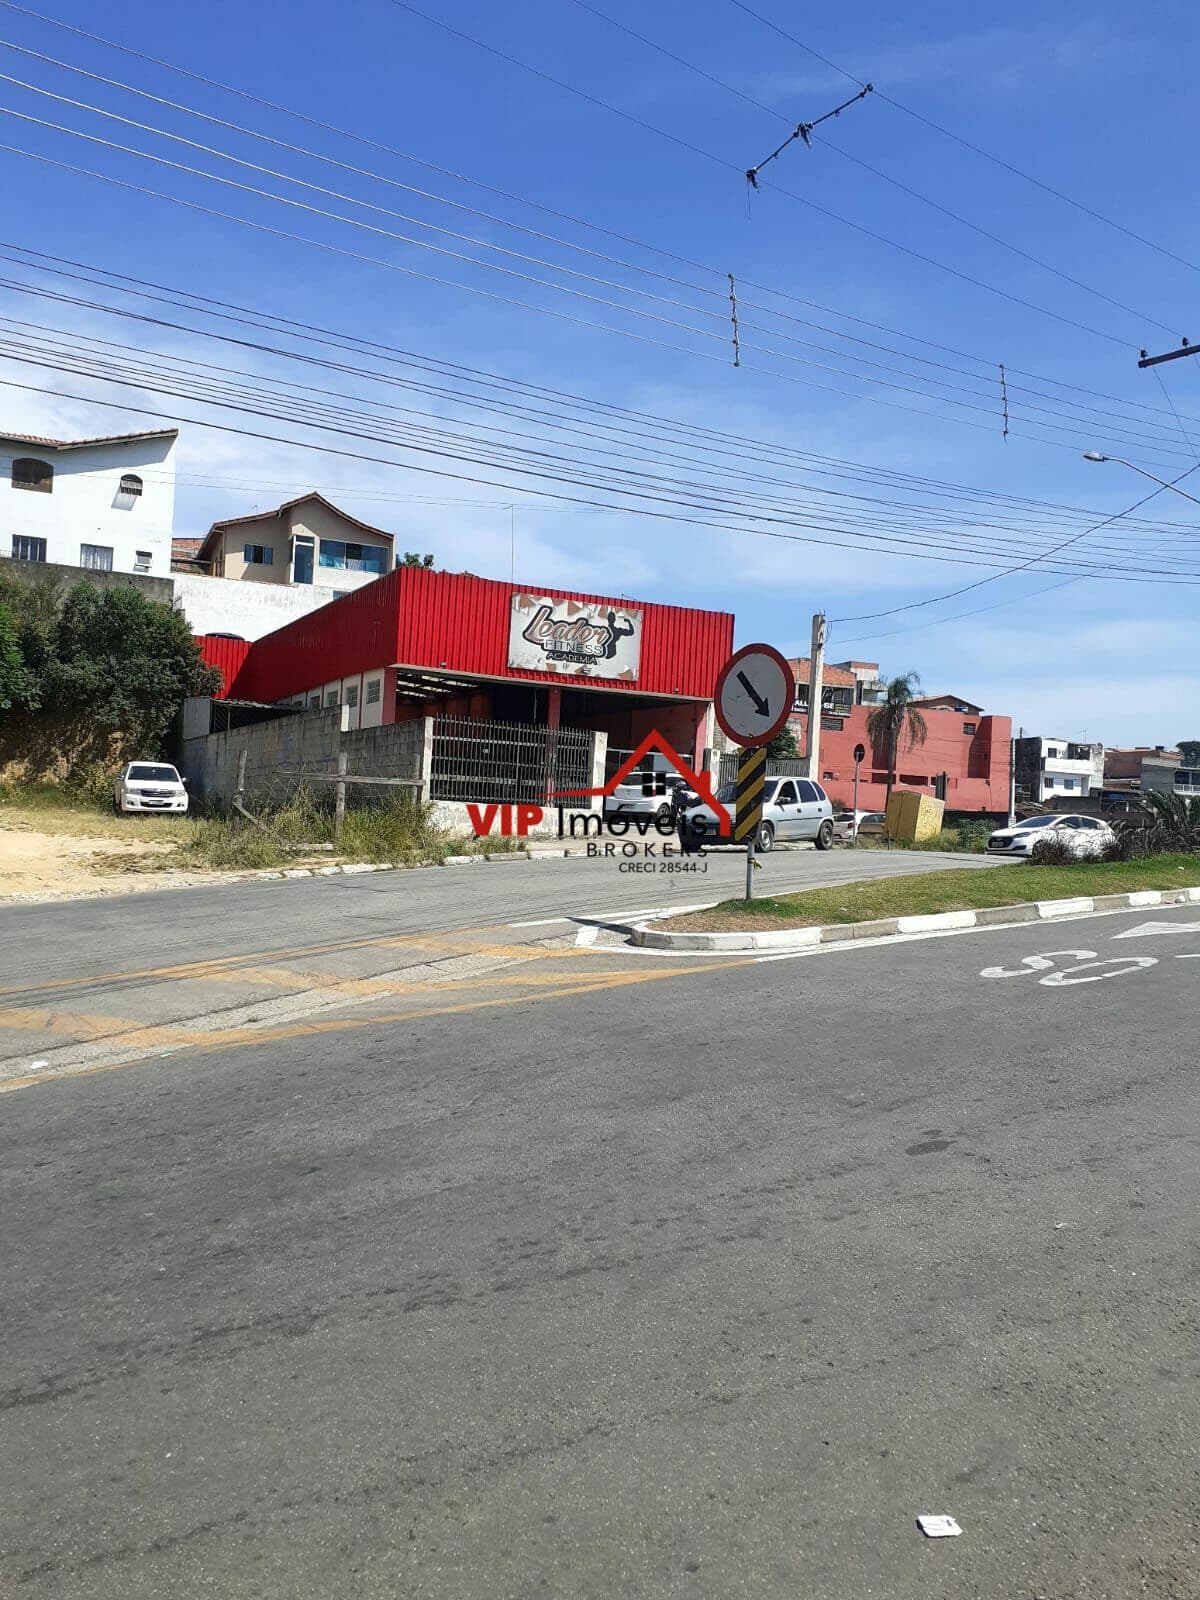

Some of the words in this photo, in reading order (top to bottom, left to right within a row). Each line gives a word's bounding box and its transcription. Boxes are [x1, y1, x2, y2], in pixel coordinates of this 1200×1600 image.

[524, 605, 612, 644] Leader
[545, 639, 603, 655] FITNESS
[547, 653, 598, 665] ACADEMIA
